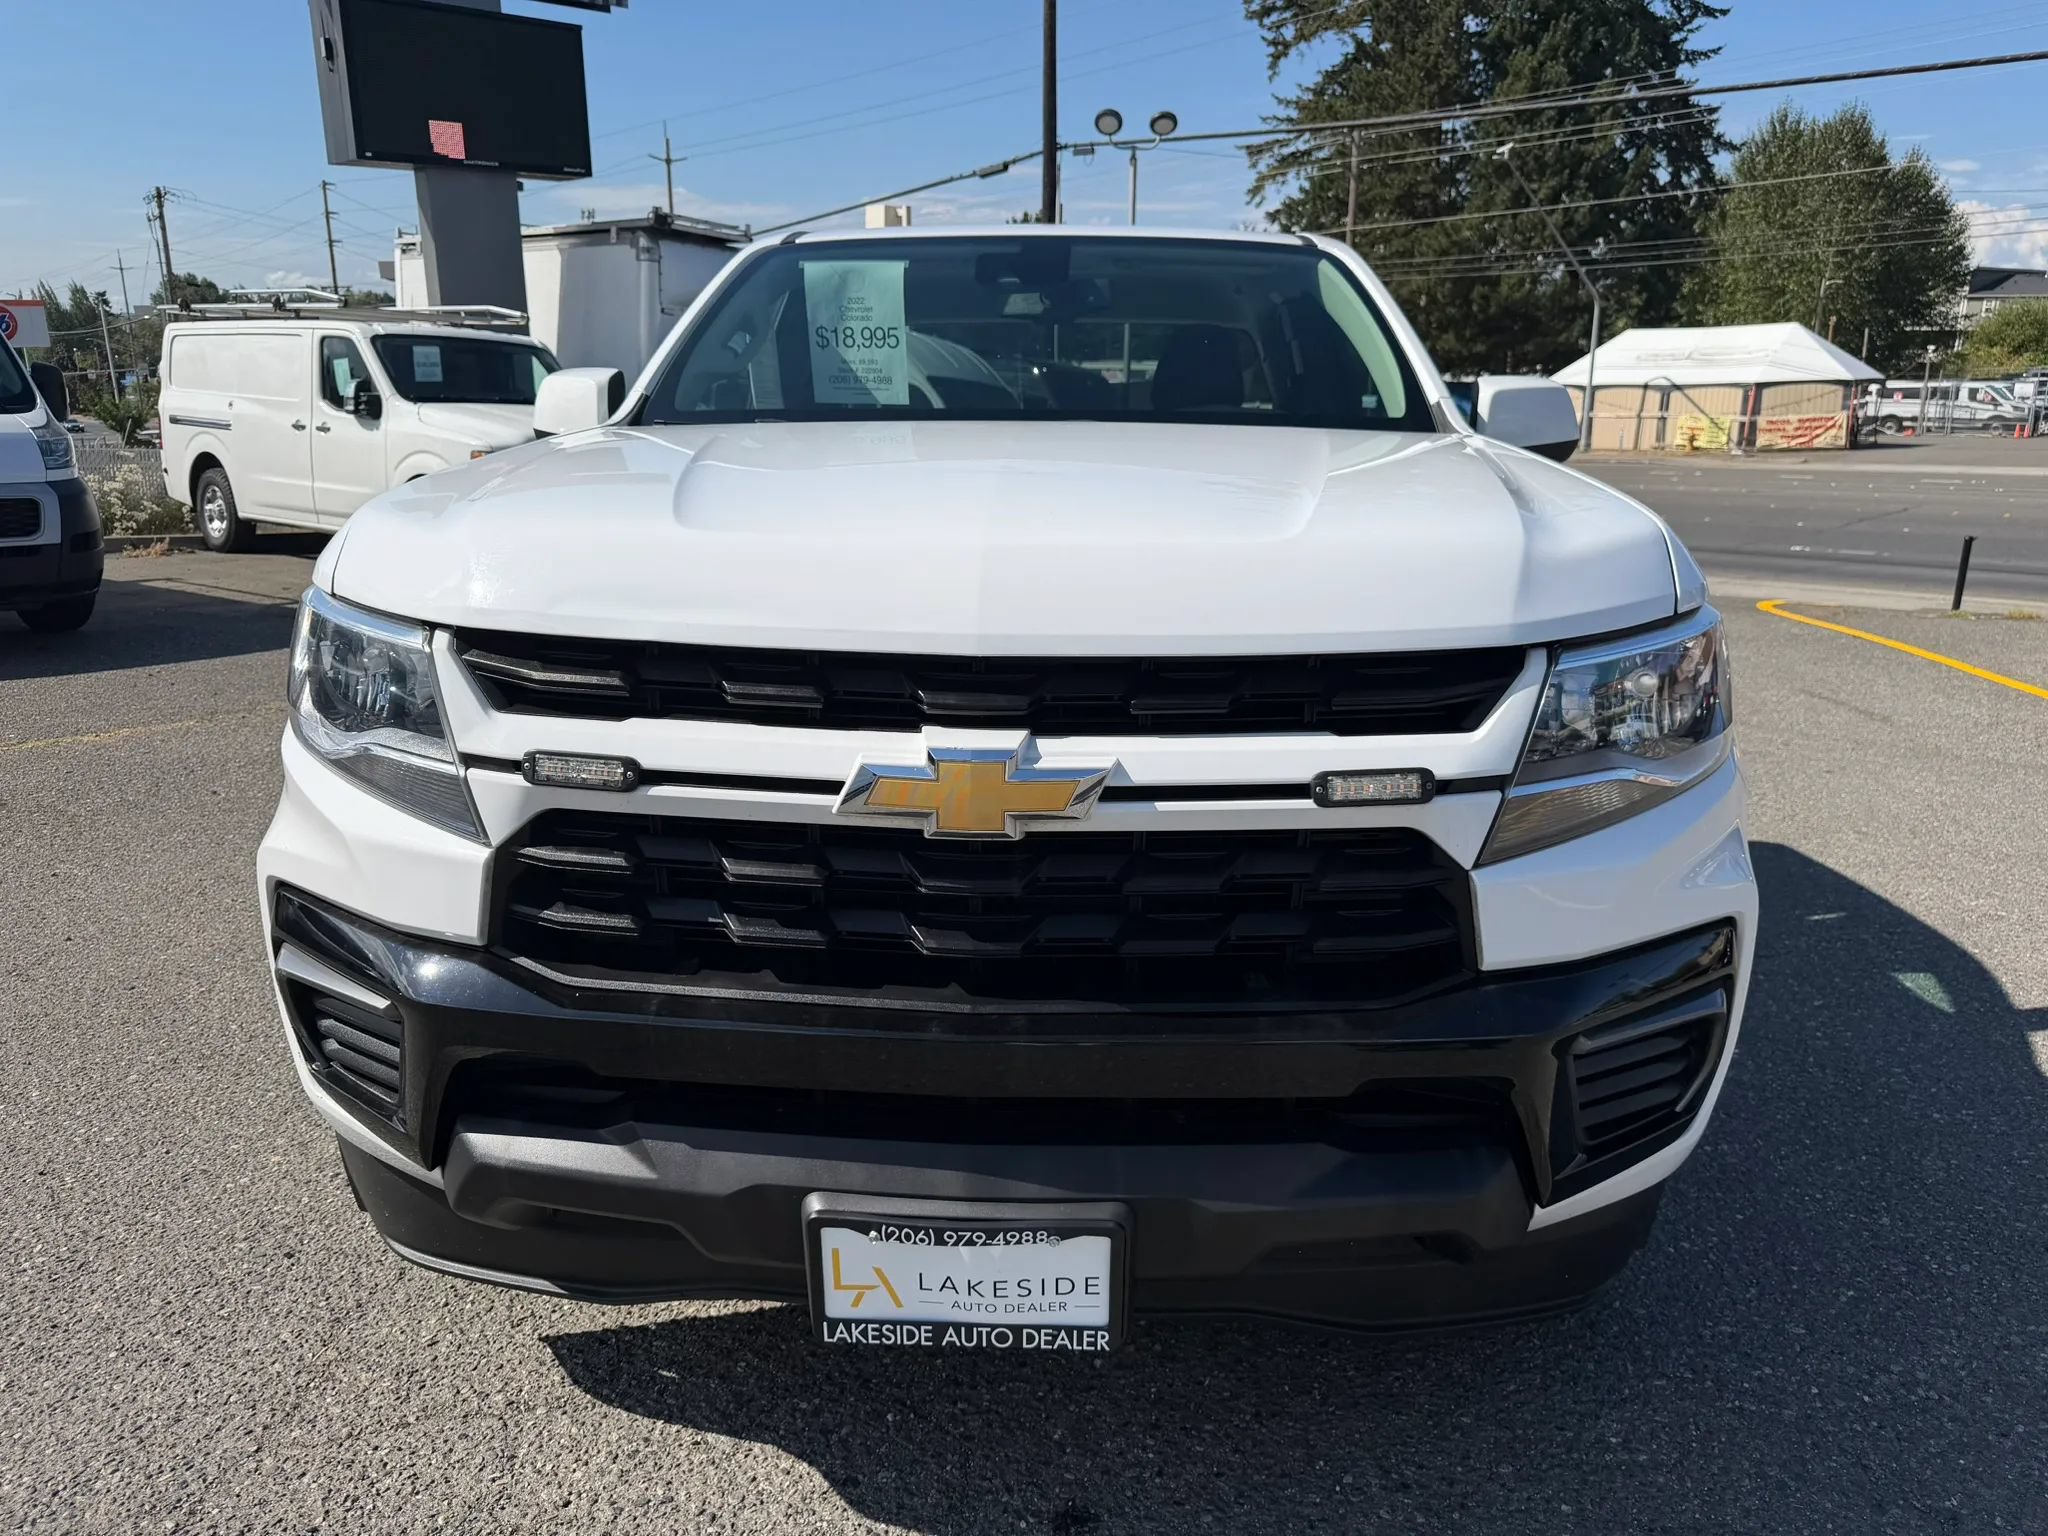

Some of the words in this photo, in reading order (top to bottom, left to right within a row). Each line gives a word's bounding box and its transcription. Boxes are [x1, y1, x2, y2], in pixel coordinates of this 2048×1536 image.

[815, 325, 900, 352] $18,995
[881, 1224, 935, 1246] (206)
[943, 1230, 1049, 1247] 979-4988
[919, 1272, 1100, 1299] LAKESIDE
[951, 1300, 997, 1314] AUTO
[1004, 1301, 1067, 1314] DEALER
[822, 1321, 933, 1345] LAKESIDE
[942, 1326, 1014, 1348] AUTO
[1022, 1328, 1110, 1351] DEALER
